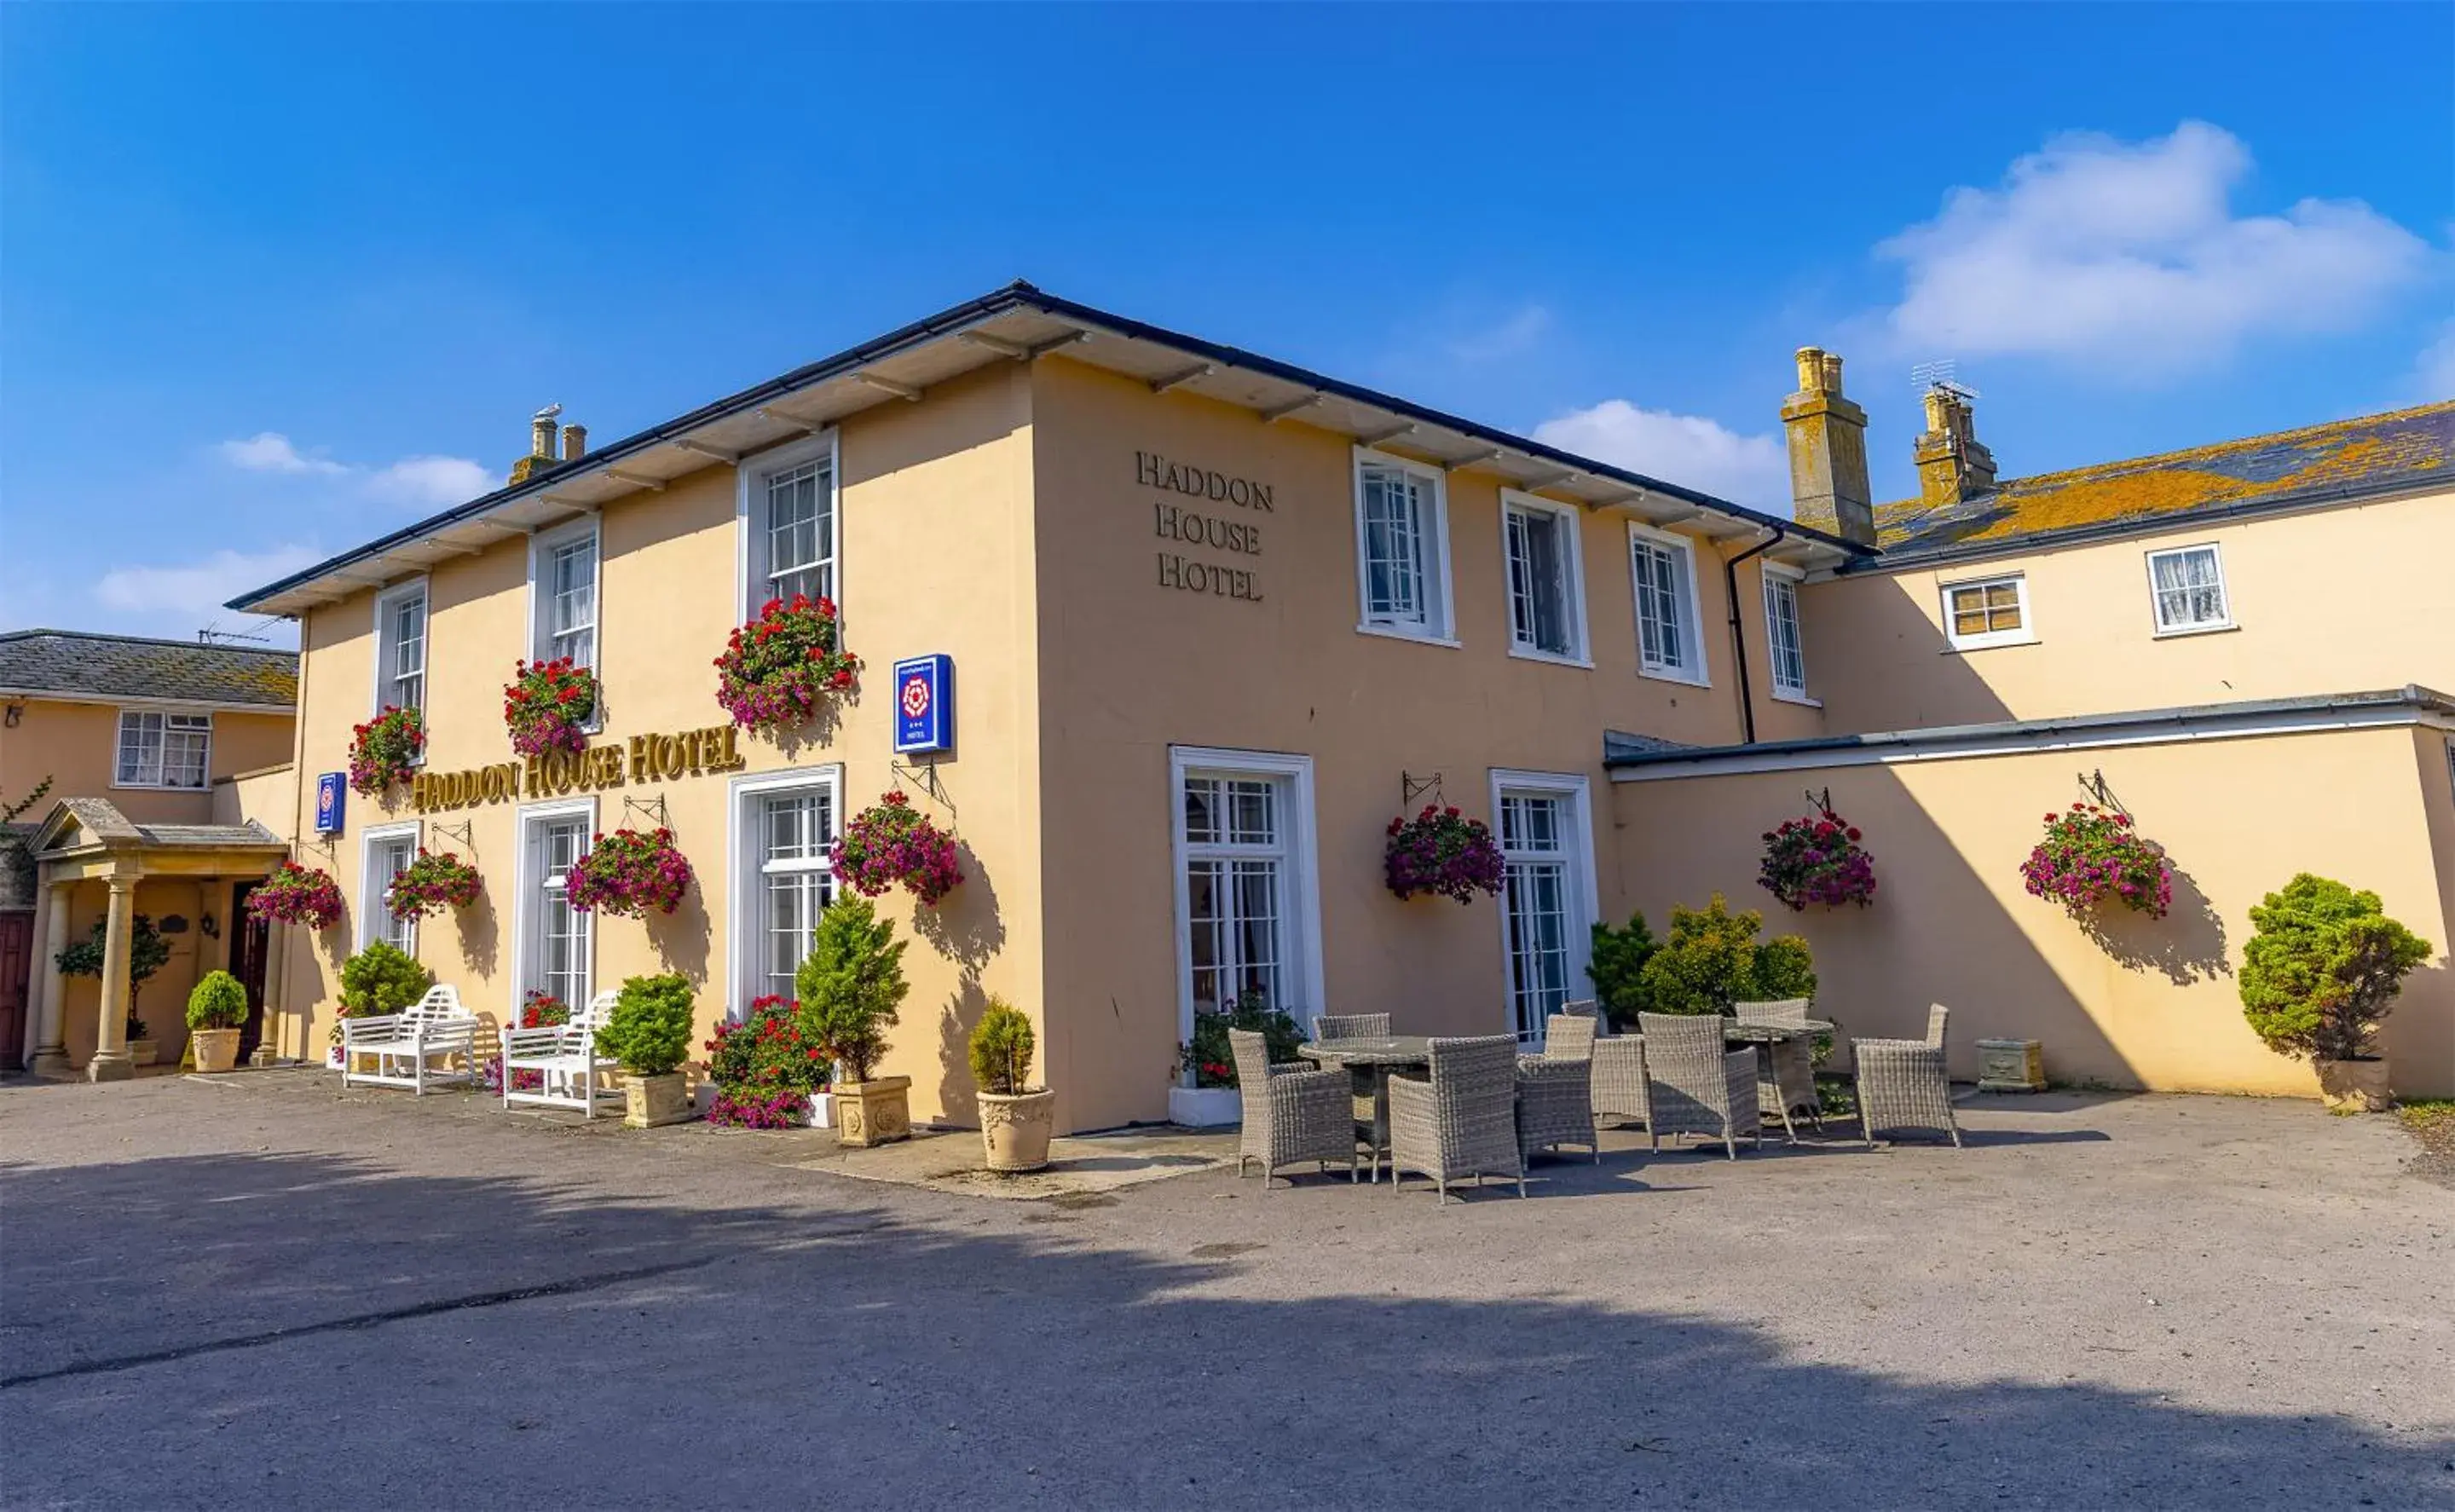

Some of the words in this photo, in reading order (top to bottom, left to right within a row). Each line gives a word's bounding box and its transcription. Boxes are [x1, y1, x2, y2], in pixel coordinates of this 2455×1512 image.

[1136, 451, 1275, 512] HADDON
[1155, 503, 1261, 555] HOUSE
[1158, 552, 1264, 602] HOTEL
[413, 762, 521, 811] HADDON
[524, 744, 624, 794] HOUSE
[627, 724, 743, 779] HOTEL
